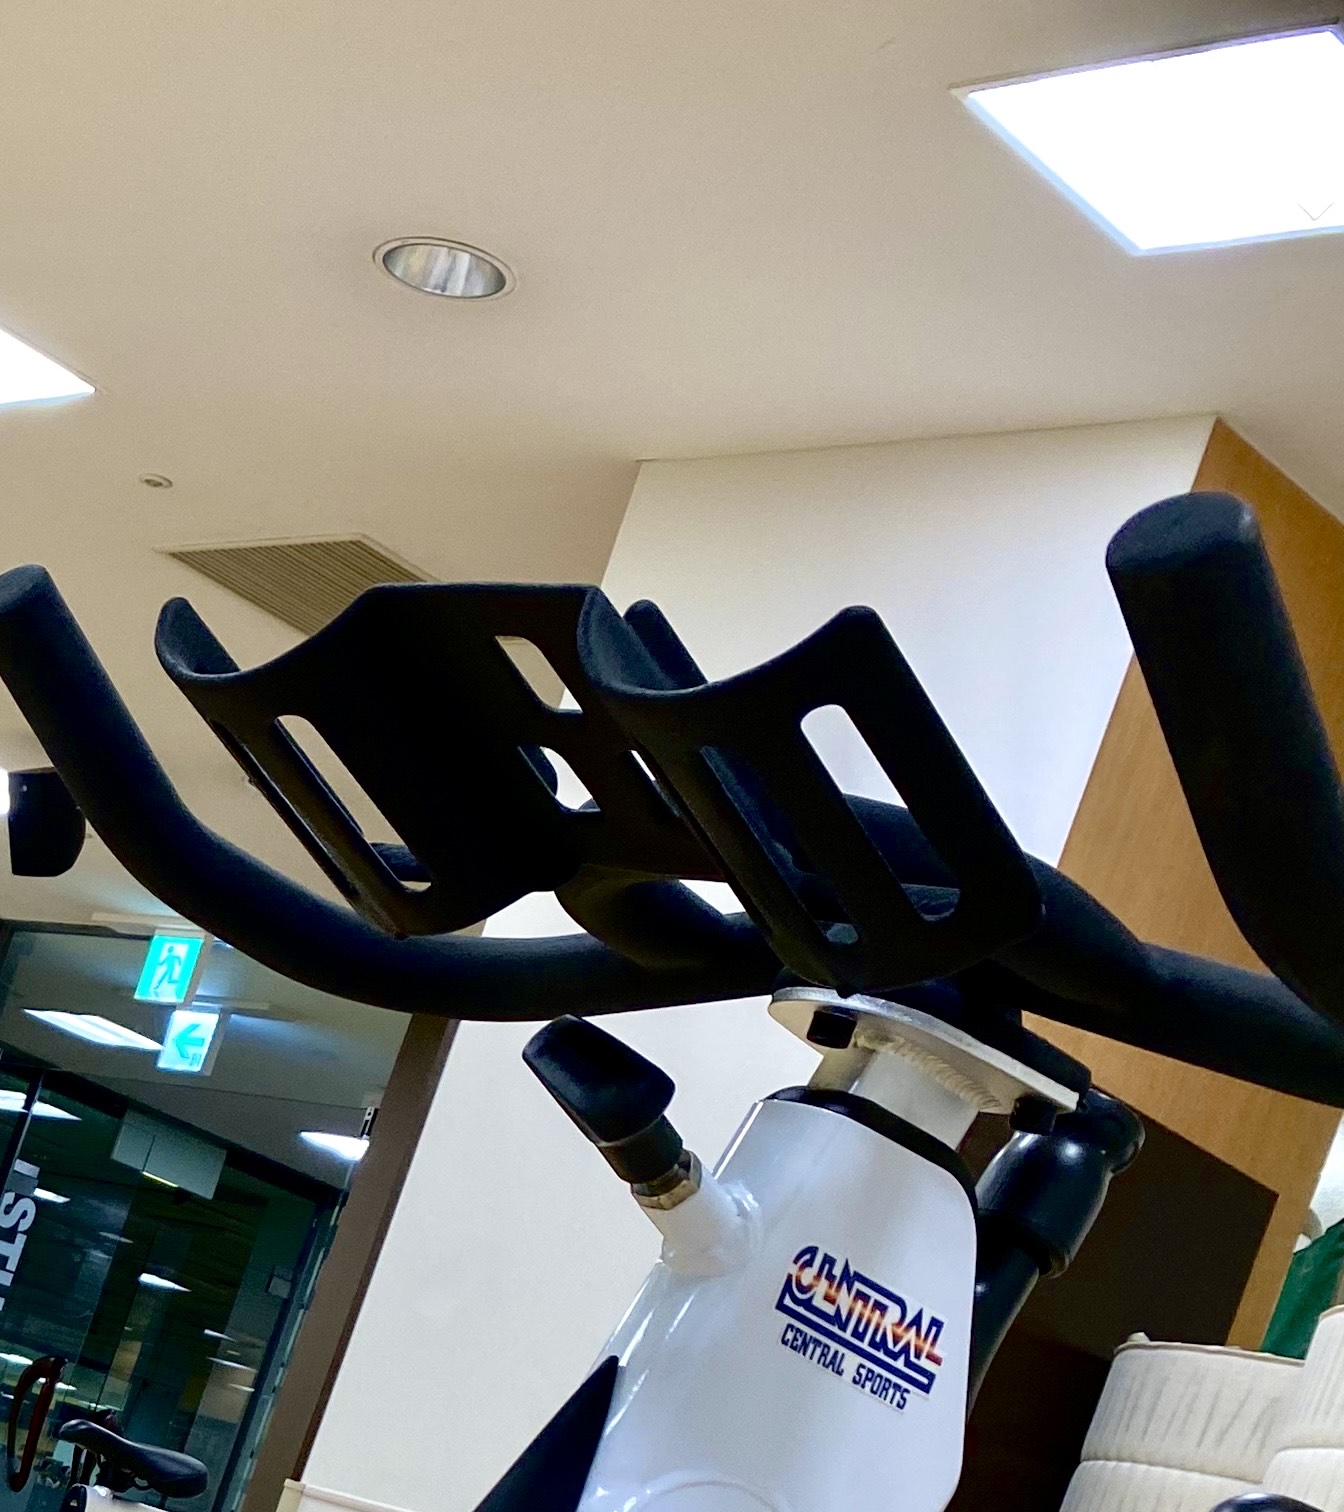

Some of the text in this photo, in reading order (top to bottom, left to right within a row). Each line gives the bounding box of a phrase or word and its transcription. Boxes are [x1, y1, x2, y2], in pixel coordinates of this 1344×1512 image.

[775, 1245, 945, 1391] CENTRAL
[780, 1323, 911, 1410] CENTRAL SPORTS
